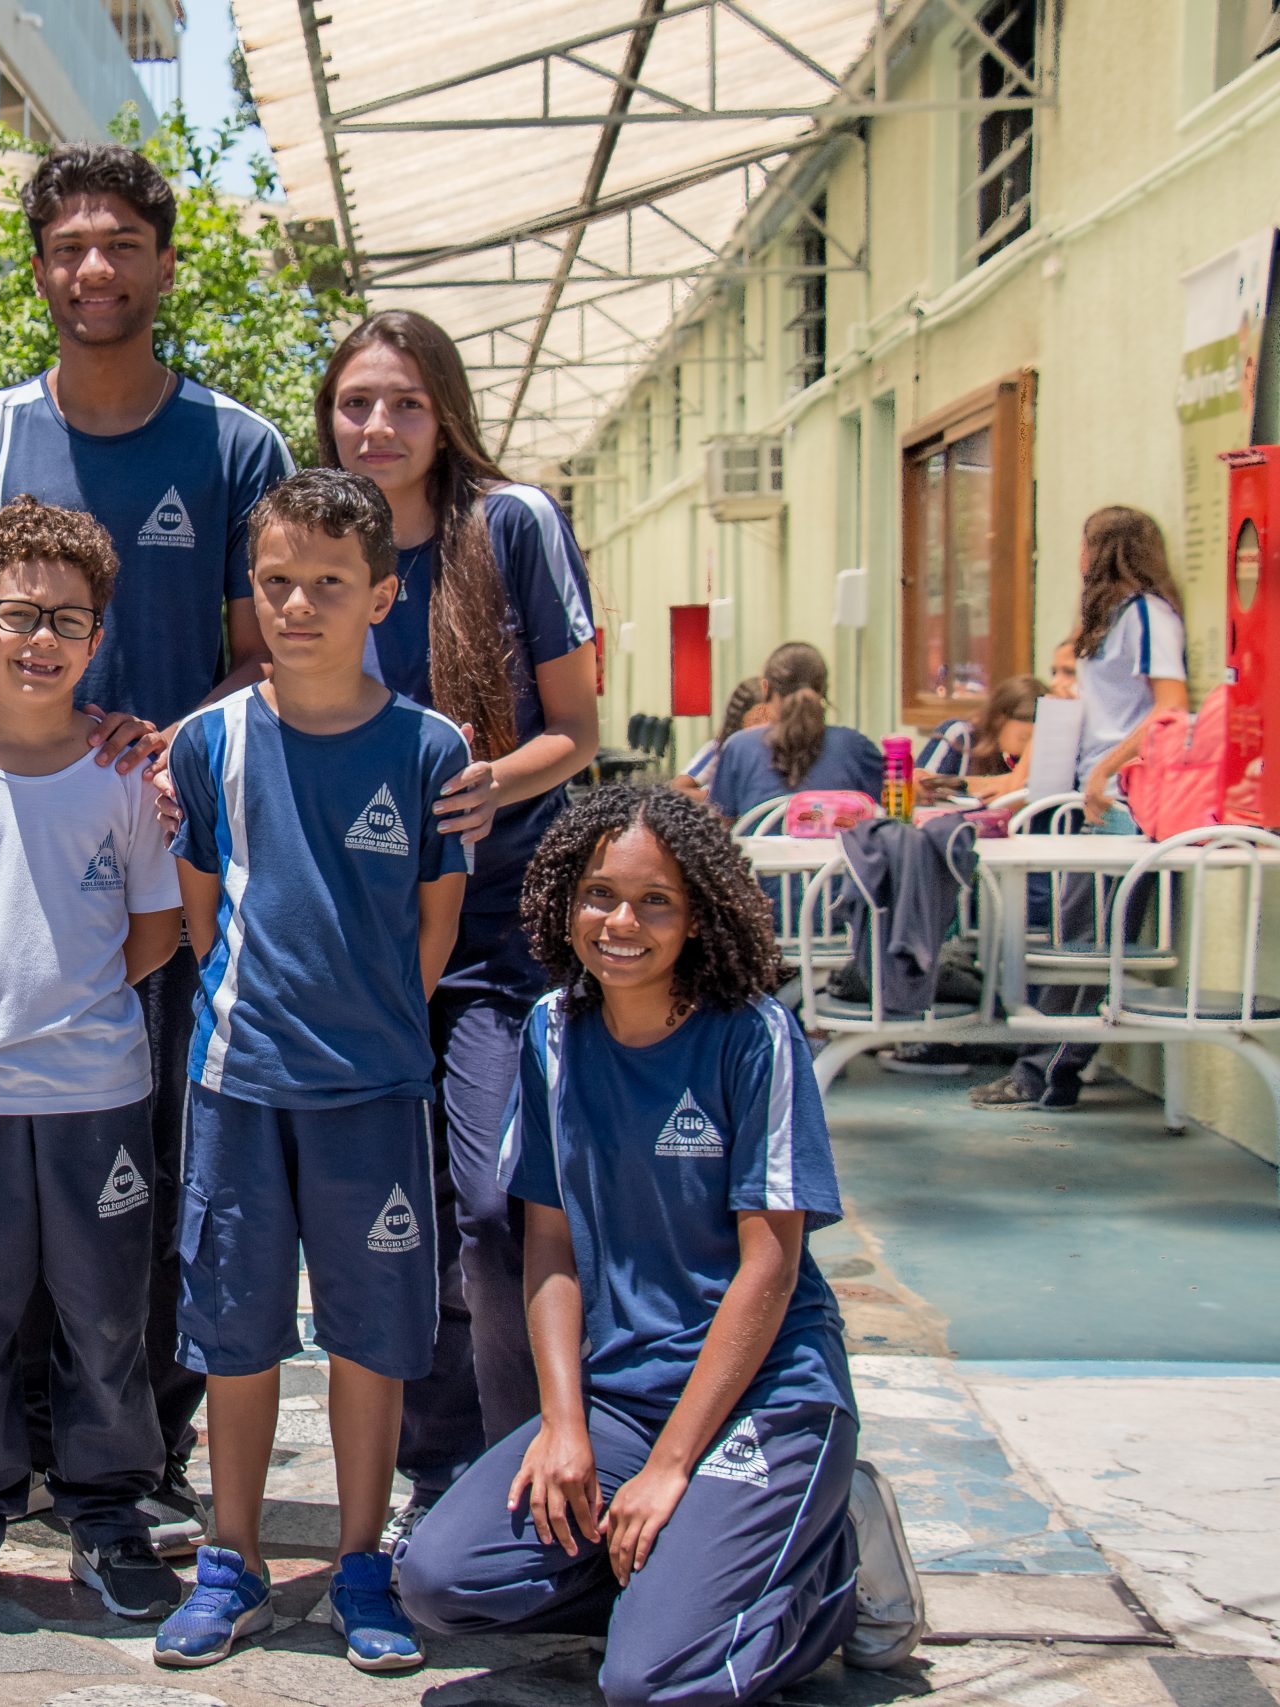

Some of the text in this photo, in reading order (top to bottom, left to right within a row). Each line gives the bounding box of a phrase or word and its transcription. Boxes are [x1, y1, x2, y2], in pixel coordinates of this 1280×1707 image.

[158, 512, 182, 523] FEIG
[368, 811, 394, 827] FEIG
[676, 1117, 704, 1130] FEIG
[112, 1172, 134, 1187] FEIG
[98, 1200, 126, 1213] COLÉGIO
[385, 1213, 410, 1226] FEIG
[367, 1239, 401, 1247] COLÉGIO
[724, 1441, 754, 1459] FEIG
